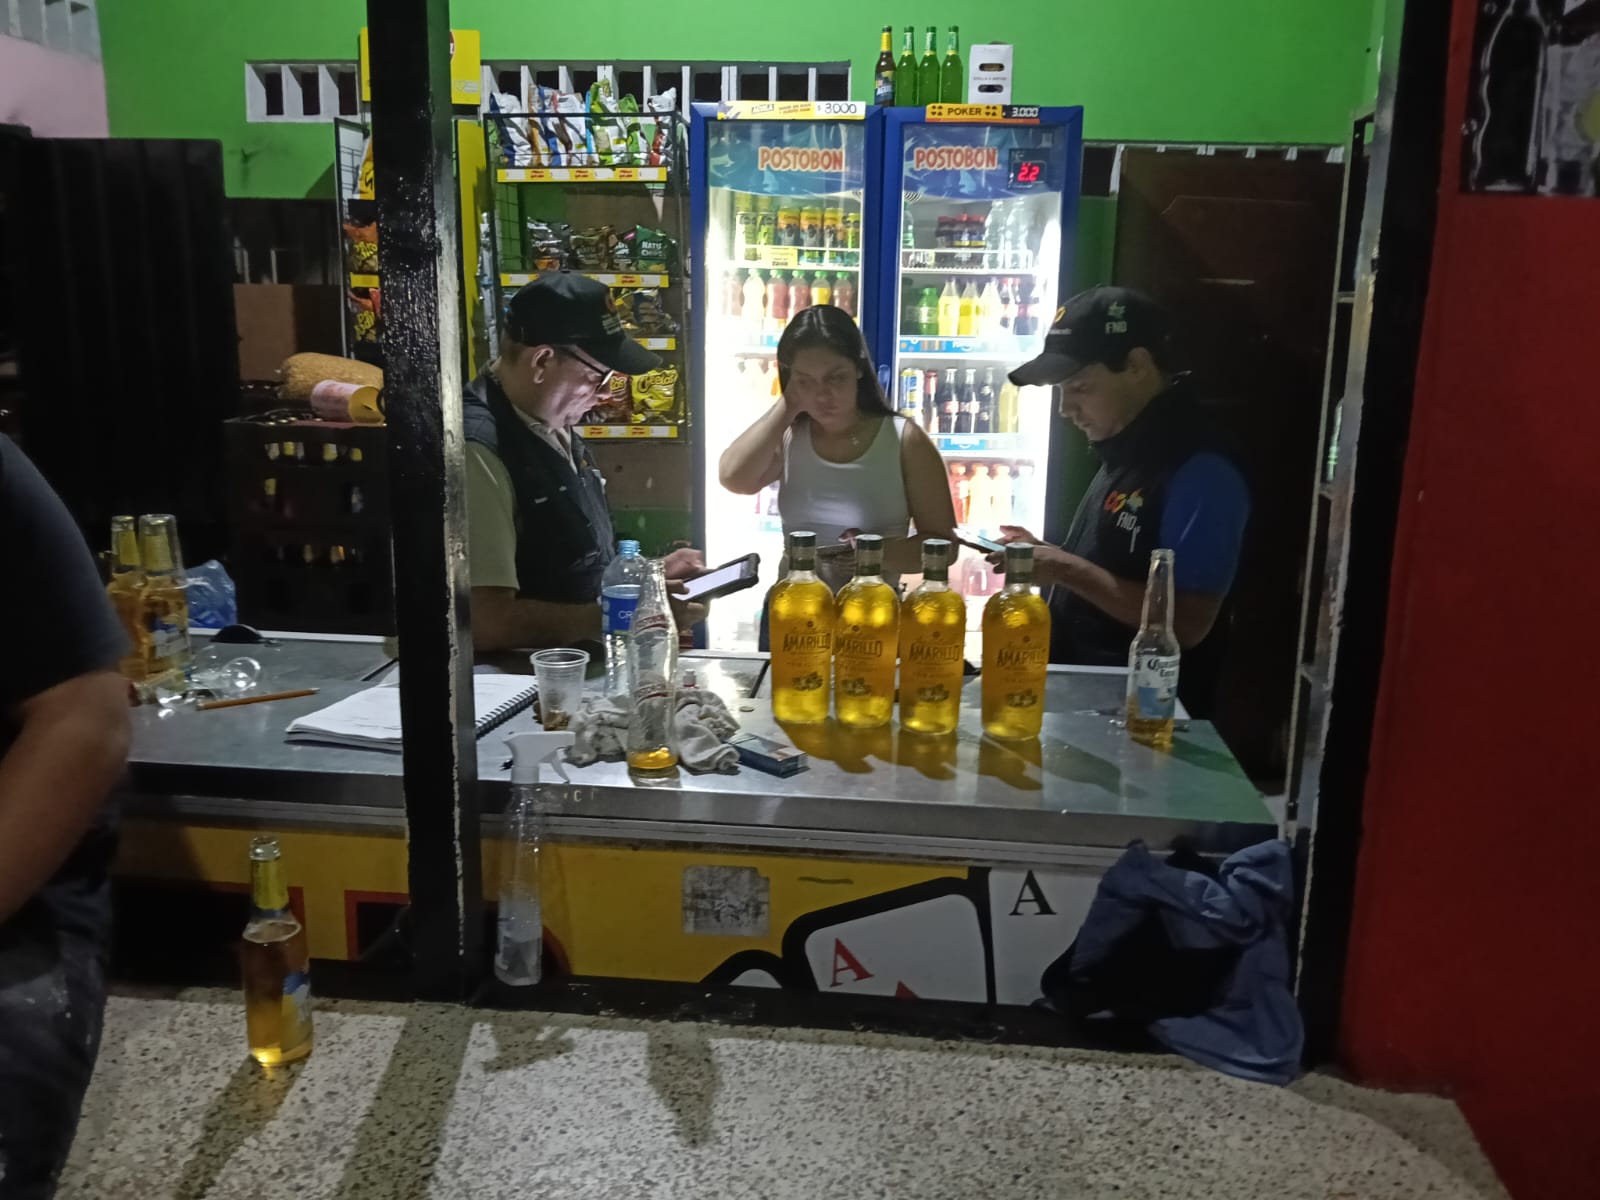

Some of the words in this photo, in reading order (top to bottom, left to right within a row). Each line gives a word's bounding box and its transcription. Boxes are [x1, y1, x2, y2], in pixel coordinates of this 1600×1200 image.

[824, 103, 857, 114] 3000
[947, 107, 982, 116] POKER
[759, 147, 844, 171] POSTOBON
[914, 146, 998, 171] POSTOBON
[1008, 869, 1058, 916] A
[829, 937, 874, 988] A
